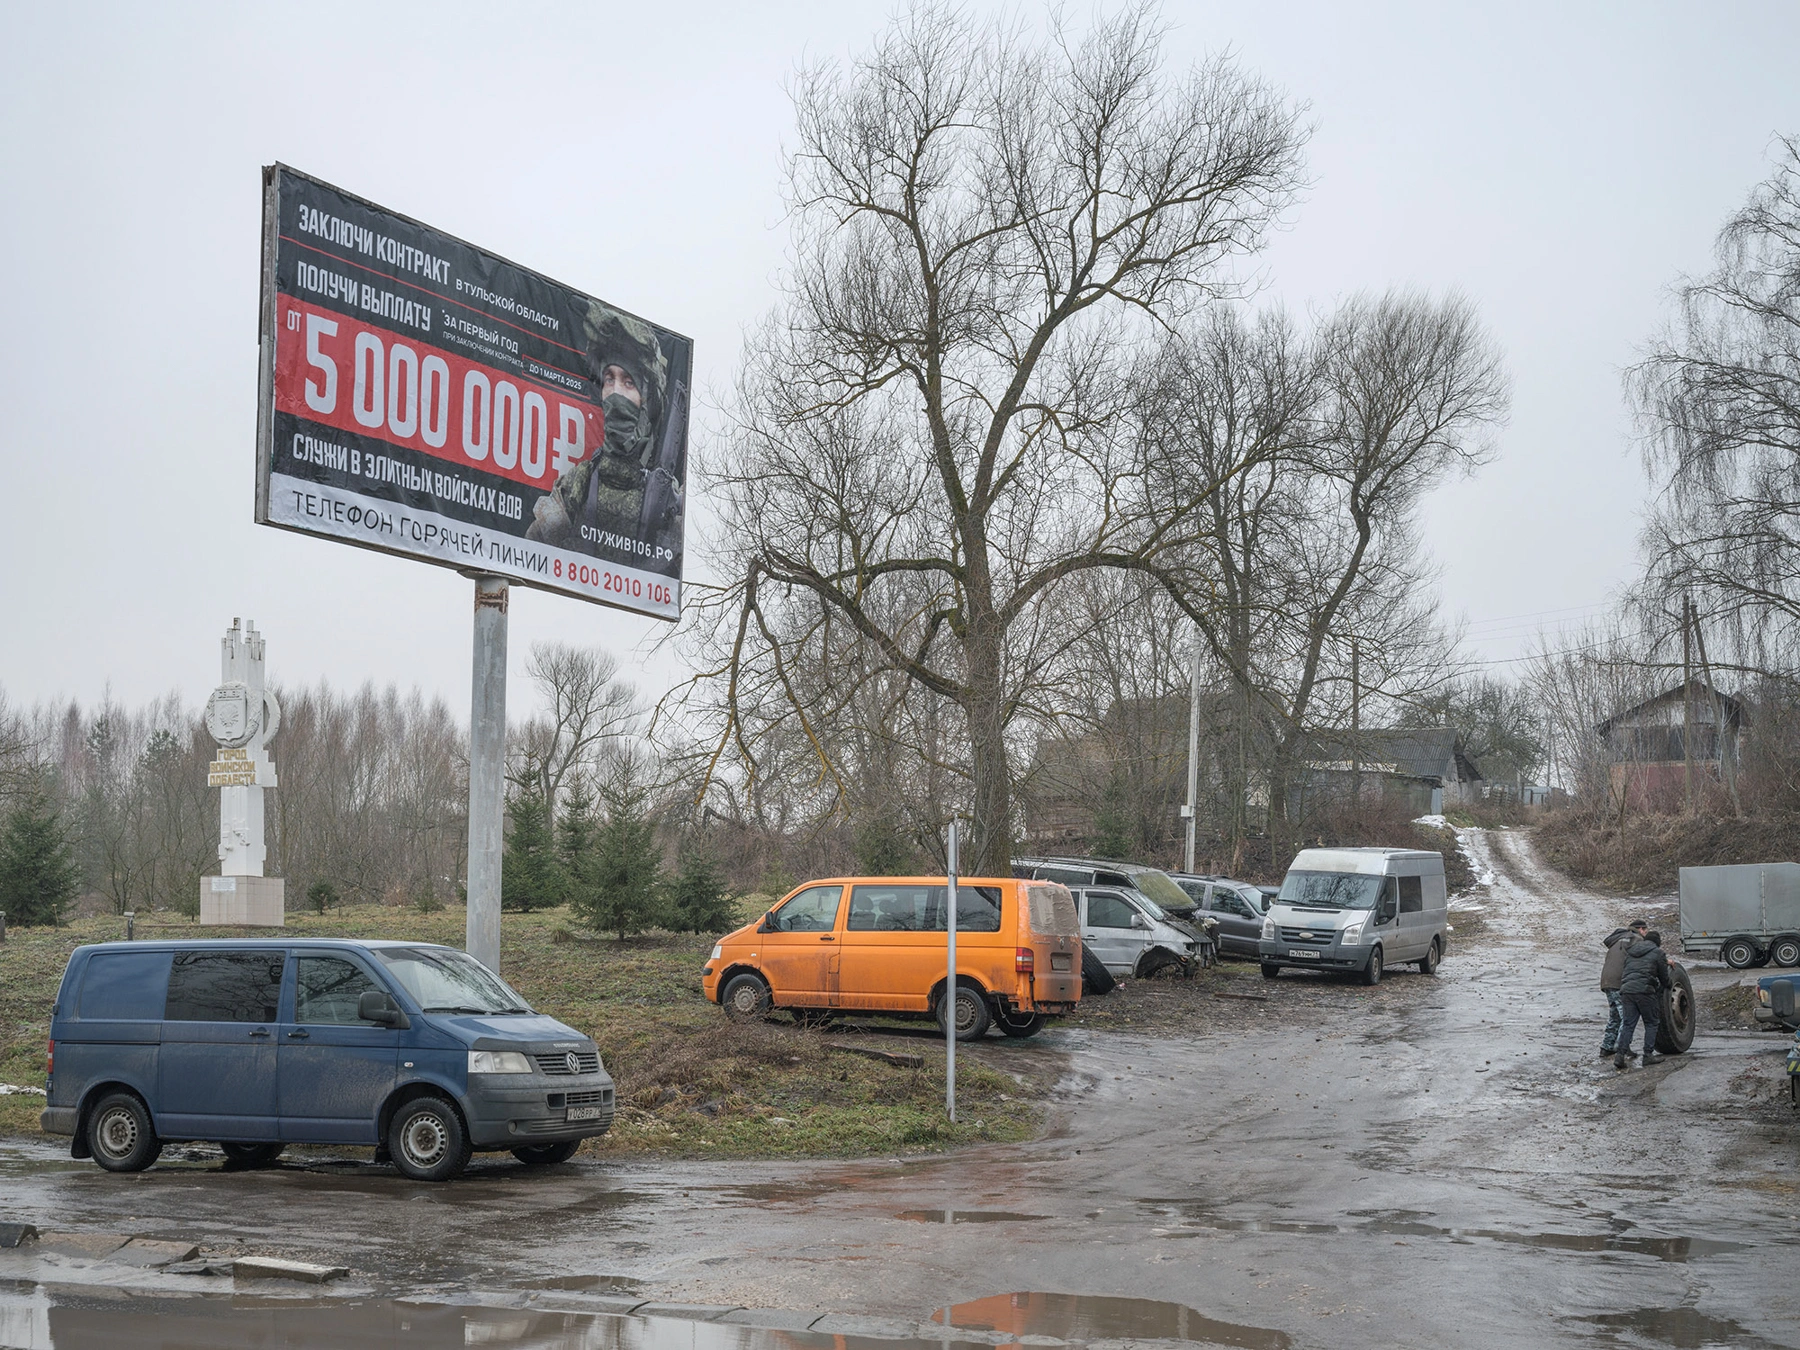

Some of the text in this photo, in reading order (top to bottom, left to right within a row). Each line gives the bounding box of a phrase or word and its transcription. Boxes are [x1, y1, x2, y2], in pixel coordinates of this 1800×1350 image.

[298, 203, 451, 286] ЗАКЛЮЧИ КОНТРАКТ
[287, 309, 302, 332] ОТ
[297, 260, 431, 332] ПОЛУЧИ ВЫПЛАТУ
[455, 278, 560, 331] В ТУЛЬСКОЙ ОБЛАСТИ
[442, 330, 456, 344] ПРИ
[494, 350, 524, 369] КОНТРАКТА
[458, 320, 499, 344] ПЕРВЫЙ
[500, 336, 519, 355] ГОД
[304, 313, 339, 415] 5
[352, 331, 450, 448] 000
[462, 369, 548, 479] 000
[529, 363, 582, 391] ДО 1 МАРТА 2025
[292, 433, 523, 521] СЛУЖИ В ЭЛИТНЫХ ВОЙСКАХ ВДВ
[292, 490, 672, 605] ТЕЛЕФОН ГОРЯЧЕЙ ЛИНИИ 8 800 2010 106
[580, 524, 674, 562] СЛУЖИВ106.РФ
